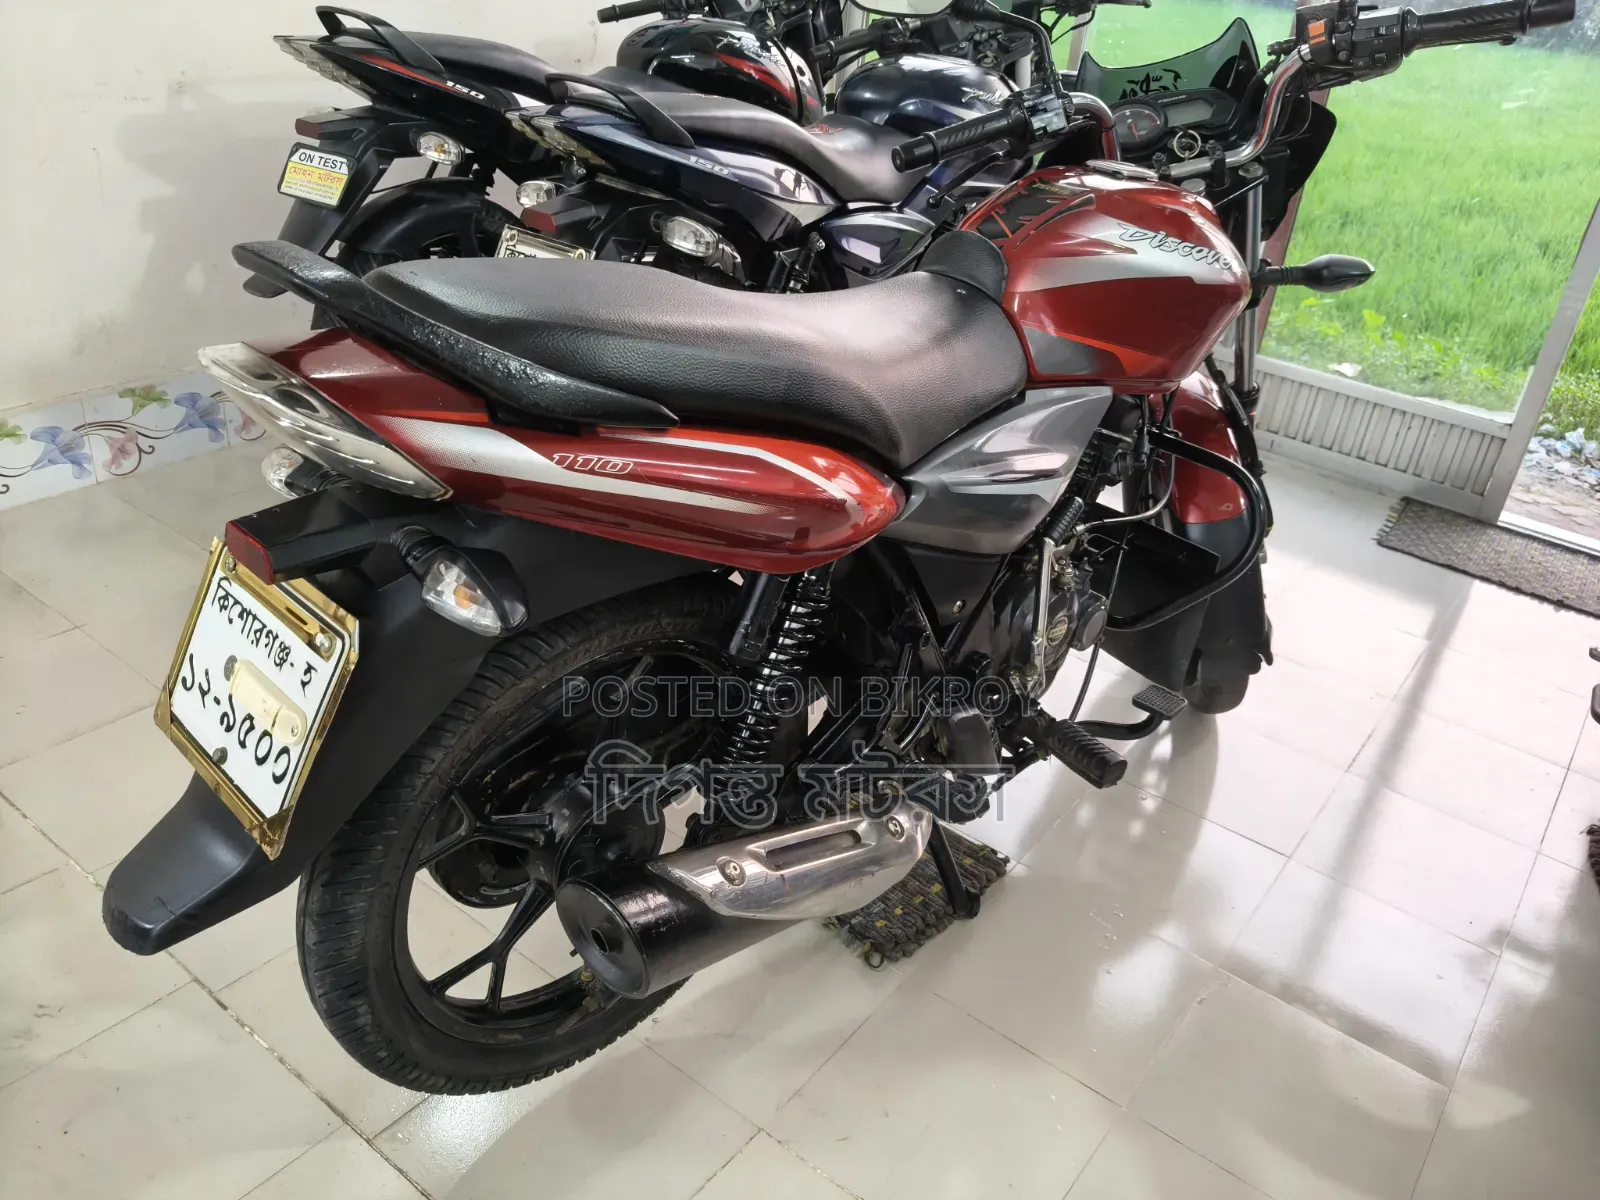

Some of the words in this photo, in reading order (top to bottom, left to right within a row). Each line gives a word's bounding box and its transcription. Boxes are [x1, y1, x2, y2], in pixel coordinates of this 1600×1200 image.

[446, 80, 485, 99] 150
[299, 152, 315, 164] ON
[318, 156, 346, 171] TEST
[690, 156, 729, 174] 150
[552, 453, 634, 475] 110
